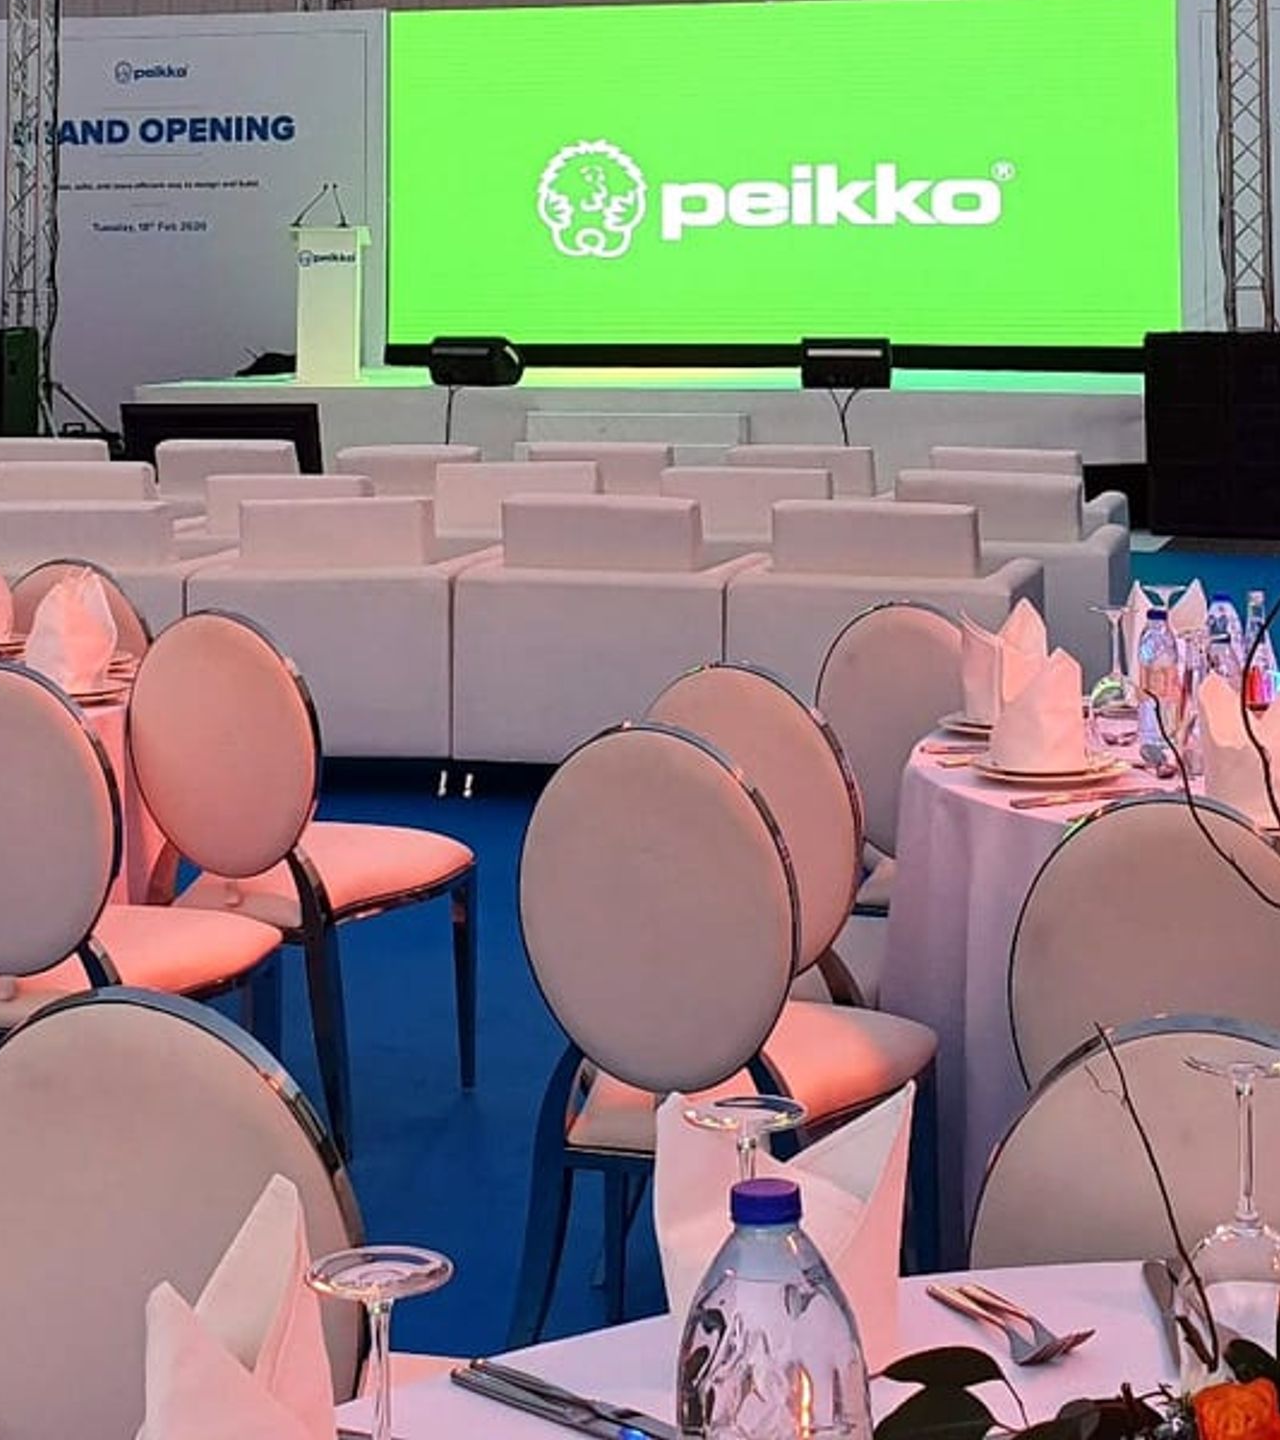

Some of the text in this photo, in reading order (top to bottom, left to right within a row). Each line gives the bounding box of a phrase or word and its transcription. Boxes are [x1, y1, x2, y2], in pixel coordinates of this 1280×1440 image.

[13, 116, 296, 146] AND OPENING
[661, 162, 1002, 241] peikko
